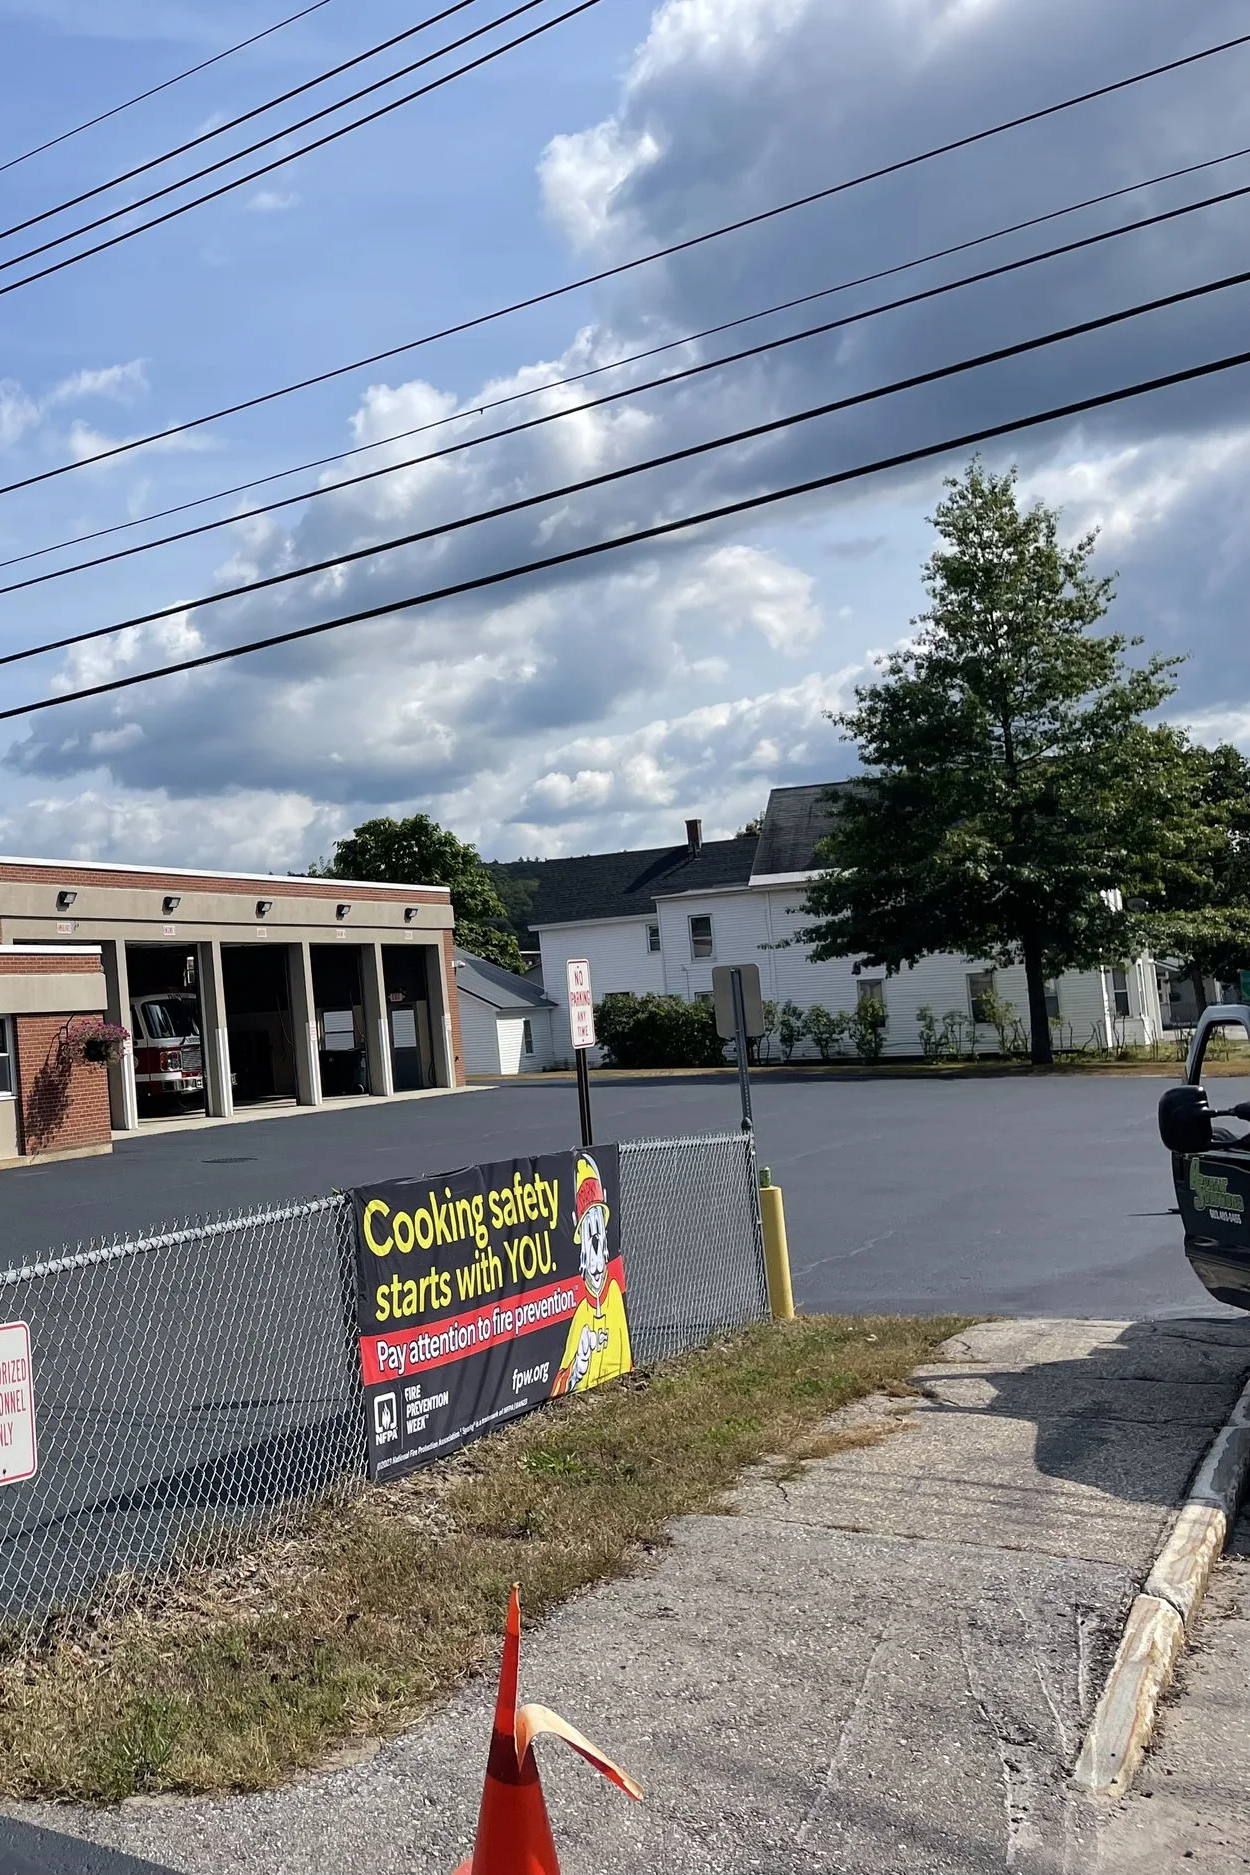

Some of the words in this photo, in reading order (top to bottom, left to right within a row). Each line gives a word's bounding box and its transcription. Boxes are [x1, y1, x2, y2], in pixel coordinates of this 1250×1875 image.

[574, 970, 583, 986] NO
[363, 1186, 489, 1257] Cooking
[489, 1171, 559, 1230] safety
[375, 1266, 452, 1322] starts
[456, 1246, 503, 1301] with
[503, 1230, 557, 1285] YOU.
[377, 1340, 407, 1375] Pay
[409, 1320, 476, 1364] attention
[477, 1315, 491, 1340] to
[492, 1307, 513, 1335] fire
[404, 1384, 421, 1402] FIRE
[512, 1361, 550, 1394] fpw.org
[406, 1391, 449, 1418] PREVENTION
